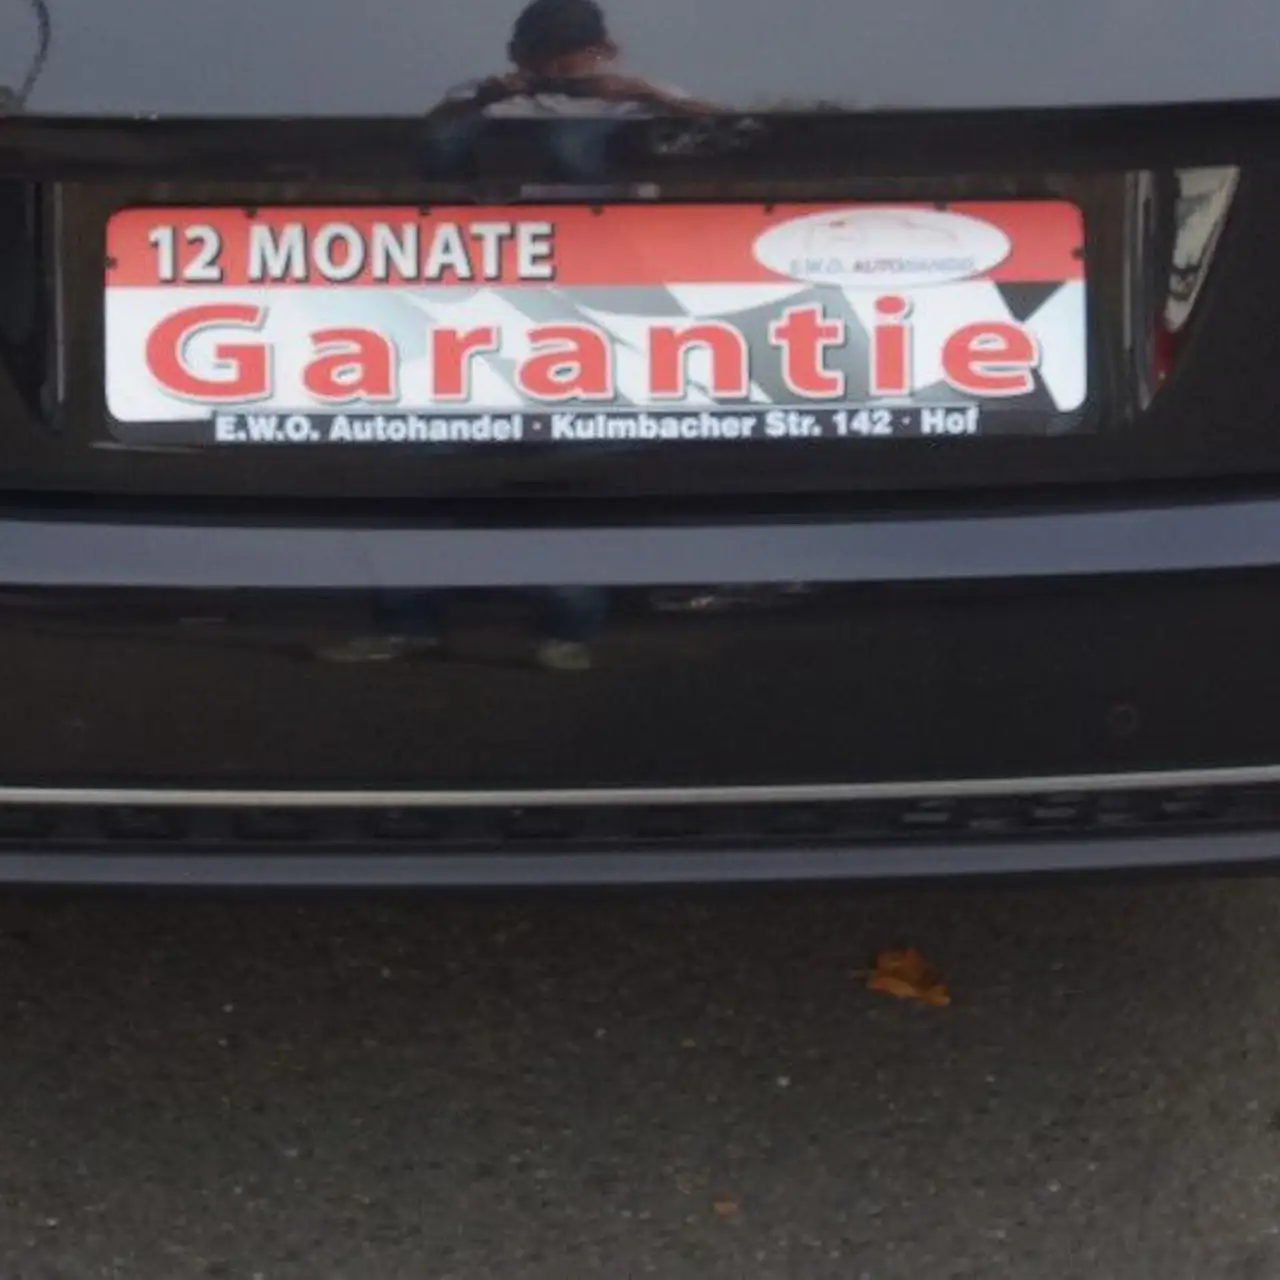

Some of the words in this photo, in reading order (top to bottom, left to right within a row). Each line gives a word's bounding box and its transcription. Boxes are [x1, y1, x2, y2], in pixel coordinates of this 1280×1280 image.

[148, 222, 223, 283] 12
[247, 222, 557, 285] MONATE
[143, 293, 1039, 403] Garantie
[215, 415, 320, 442] E.W.O.
[328, 414, 523, 441] Autohandel
[550, 412, 757, 440] Kulmbacher
[763, 409, 821, 438] Str.
[831, 408, 894, 436] 142
[920, 404, 980, 436] Hof
